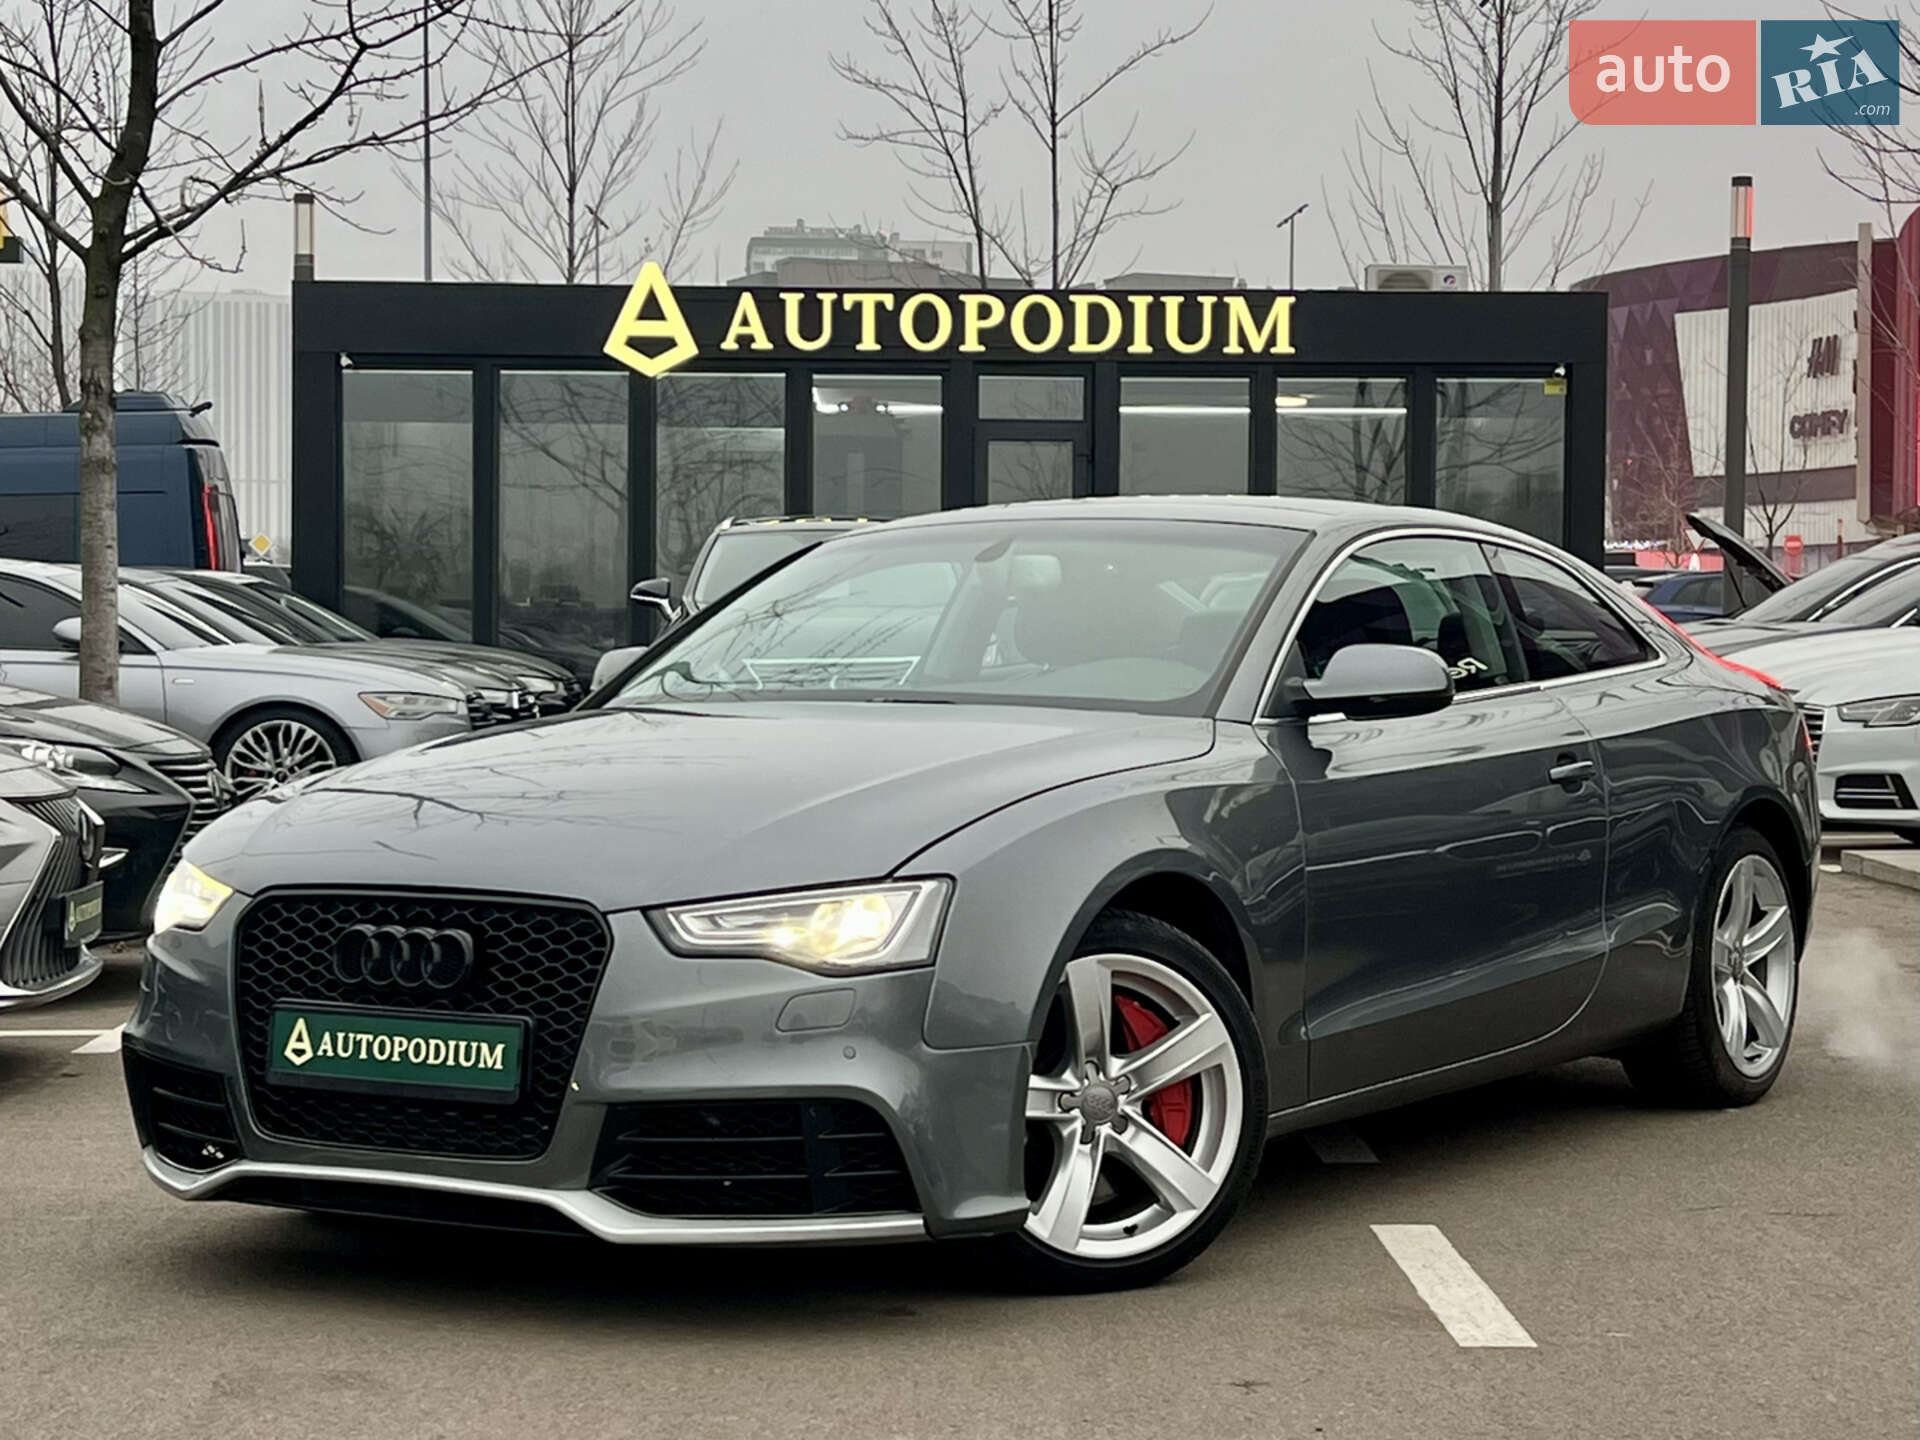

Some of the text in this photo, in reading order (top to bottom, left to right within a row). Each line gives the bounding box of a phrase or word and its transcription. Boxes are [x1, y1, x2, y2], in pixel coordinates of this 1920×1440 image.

[720, 290, 1297, 356] AUTOPODIUM
[1789, 408, 1849, 439] COMFY
[317, 1031, 505, 1070] AUTOPODIUM
